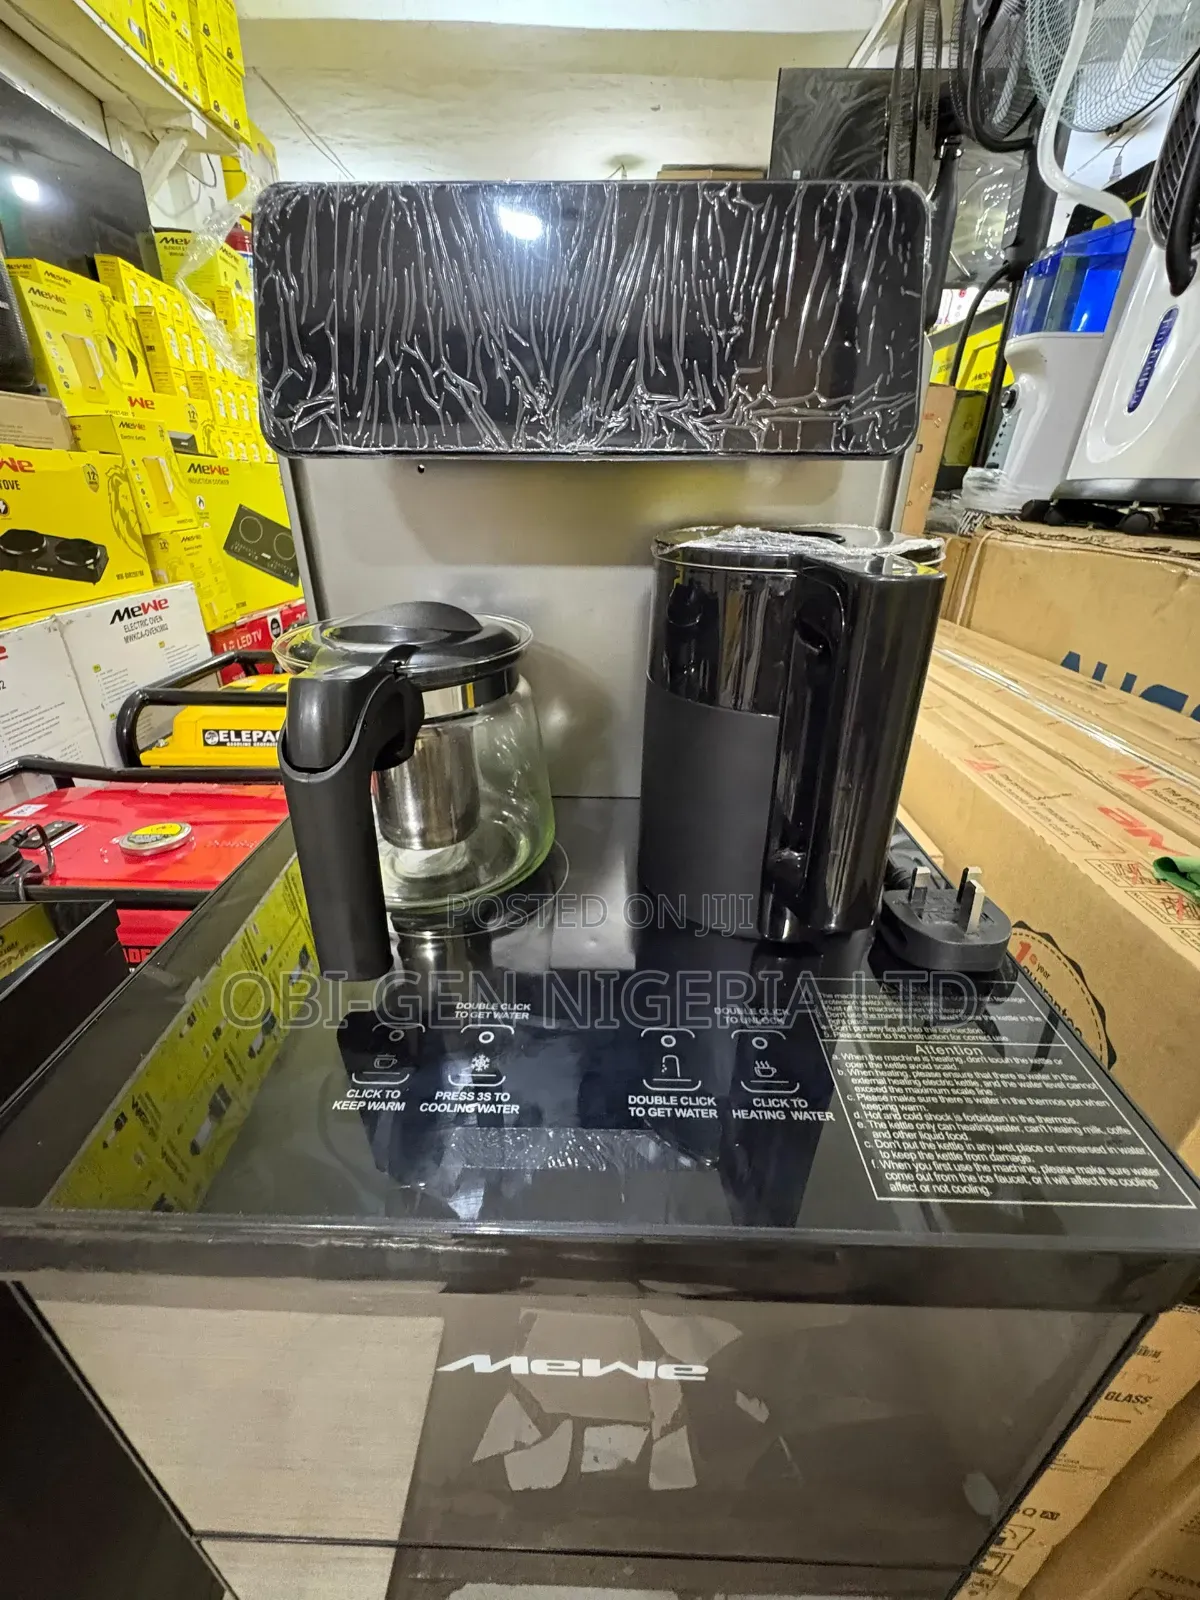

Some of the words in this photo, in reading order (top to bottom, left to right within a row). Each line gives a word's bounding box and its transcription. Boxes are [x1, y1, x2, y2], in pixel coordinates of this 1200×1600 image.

[219, 730, 280, 743] ELEPA
[456, 1002, 499, 1011] DOUBLE
[500, 1002, 531, 1011] CLICK
[714, 1007, 756, 1016] DOUBLE
[454, 1010, 469, 1019] TO
[470, 1010, 491, 1019] GET
[492, 1011, 530, 1020] WATER
[915, 1045, 984, 1056] Attention
[346, 1089, 381, 1099] CLICK
[383, 1089, 401, 1099] TO
[435, 1091, 475, 1101] PRESS
[477, 1092, 492, 1101] 3S
[495, 1092, 511, 1102] TO
[332, 1101, 367, 1111] KEEP
[367, 1101, 406, 1111] WARM
[628, 1095, 678, 1106] DOUBLE
[680, 1096, 717, 1106] CLICK
[753, 1098, 790, 1108] CLICK
[792, 1098, 808, 1108] TO
[419, 1103, 476, 1113] COOLING
[478, 1103, 520, 1114] WATER
[628, 1107, 646, 1117] TO
[648, 1107, 672, 1118] GET
[674, 1108, 718, 1119] WATER
[732, 1110, 786, 1121] HEATING
[791, 1111, 836, 1122] WATER
[1104, 1391, 1153, 1404] GLASS
